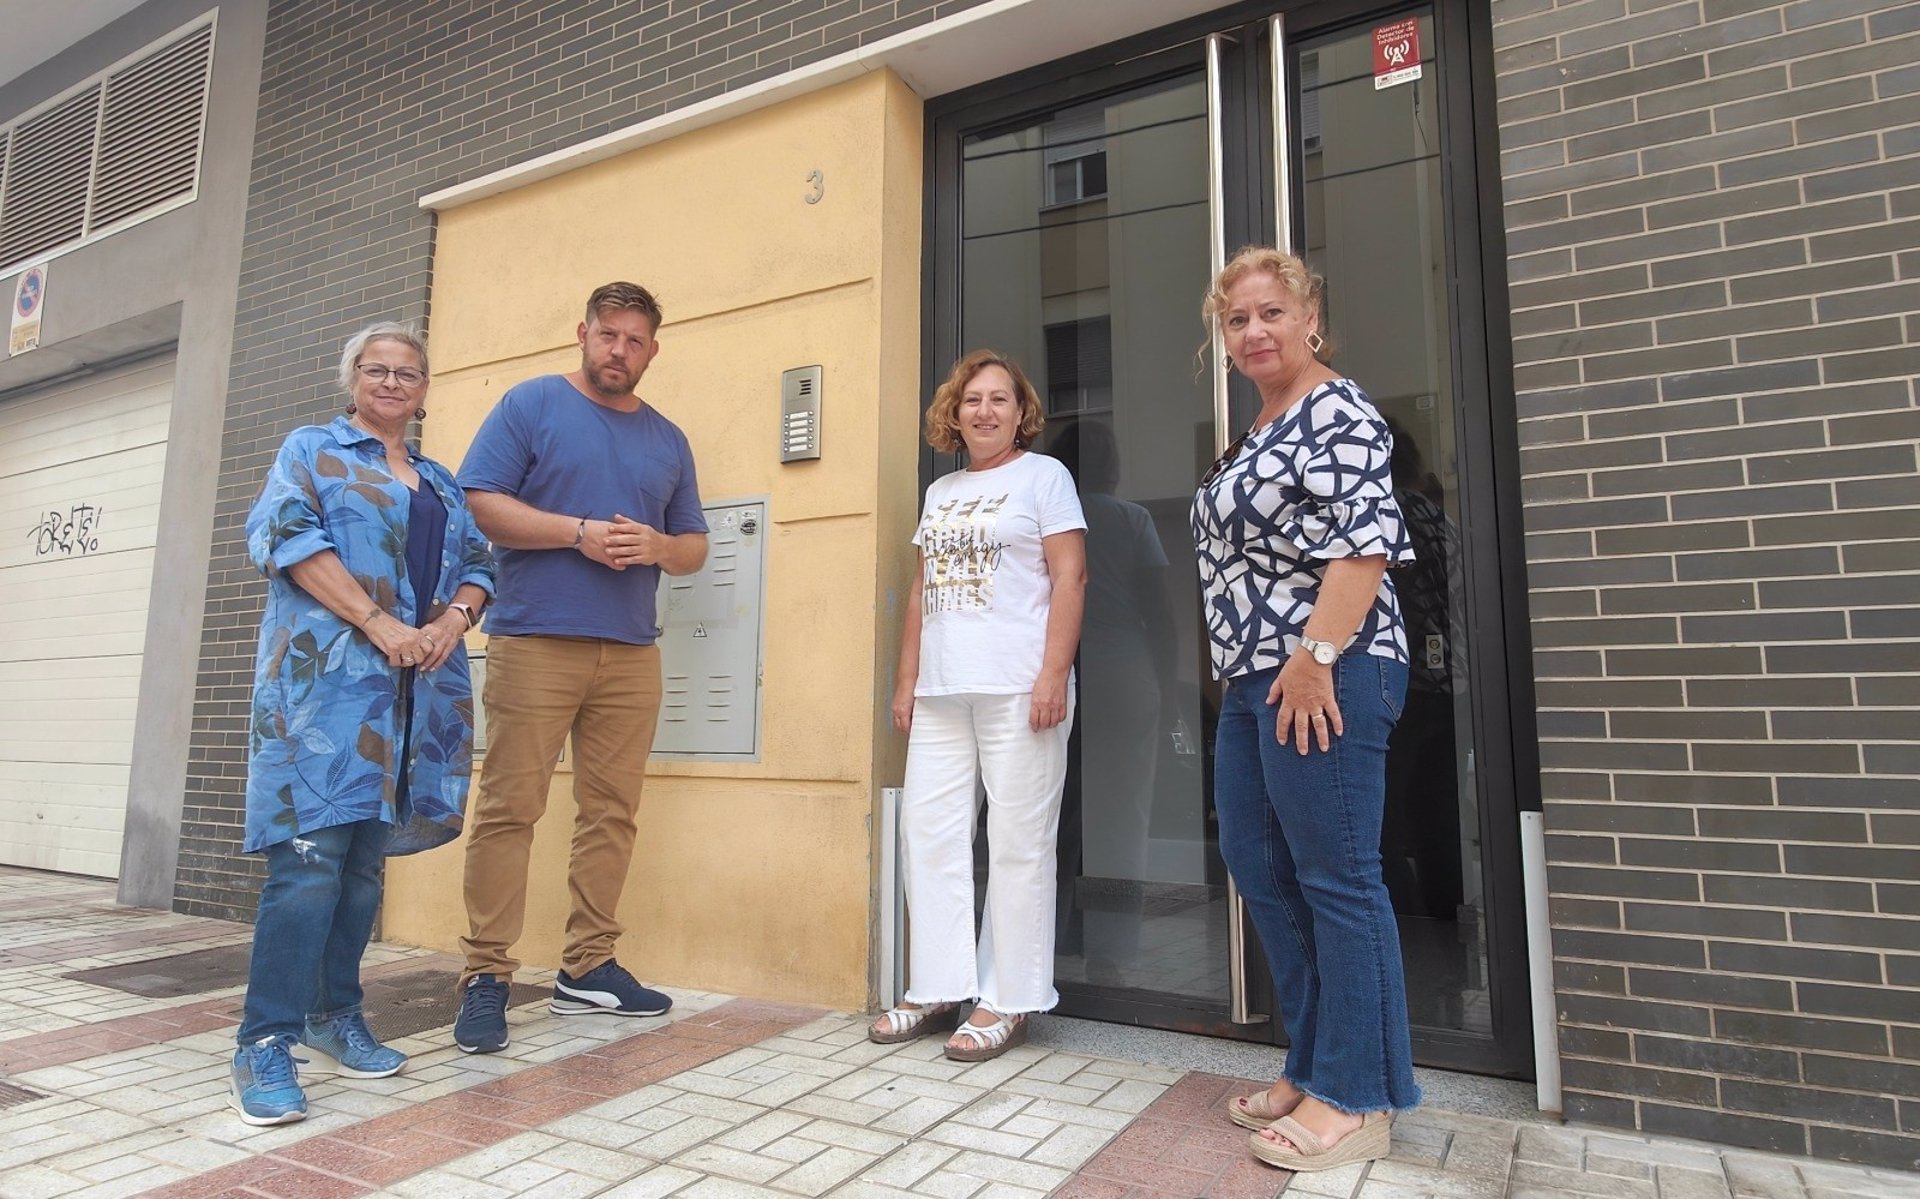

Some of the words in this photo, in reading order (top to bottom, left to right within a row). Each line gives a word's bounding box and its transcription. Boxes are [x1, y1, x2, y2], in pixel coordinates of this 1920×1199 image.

[1377, 28, 1405, 40] Detector
[1379, 24, 1400, 34] Alarma
[1401, 20, 1413, 28] con
[804, 169, 824, 205] 3
